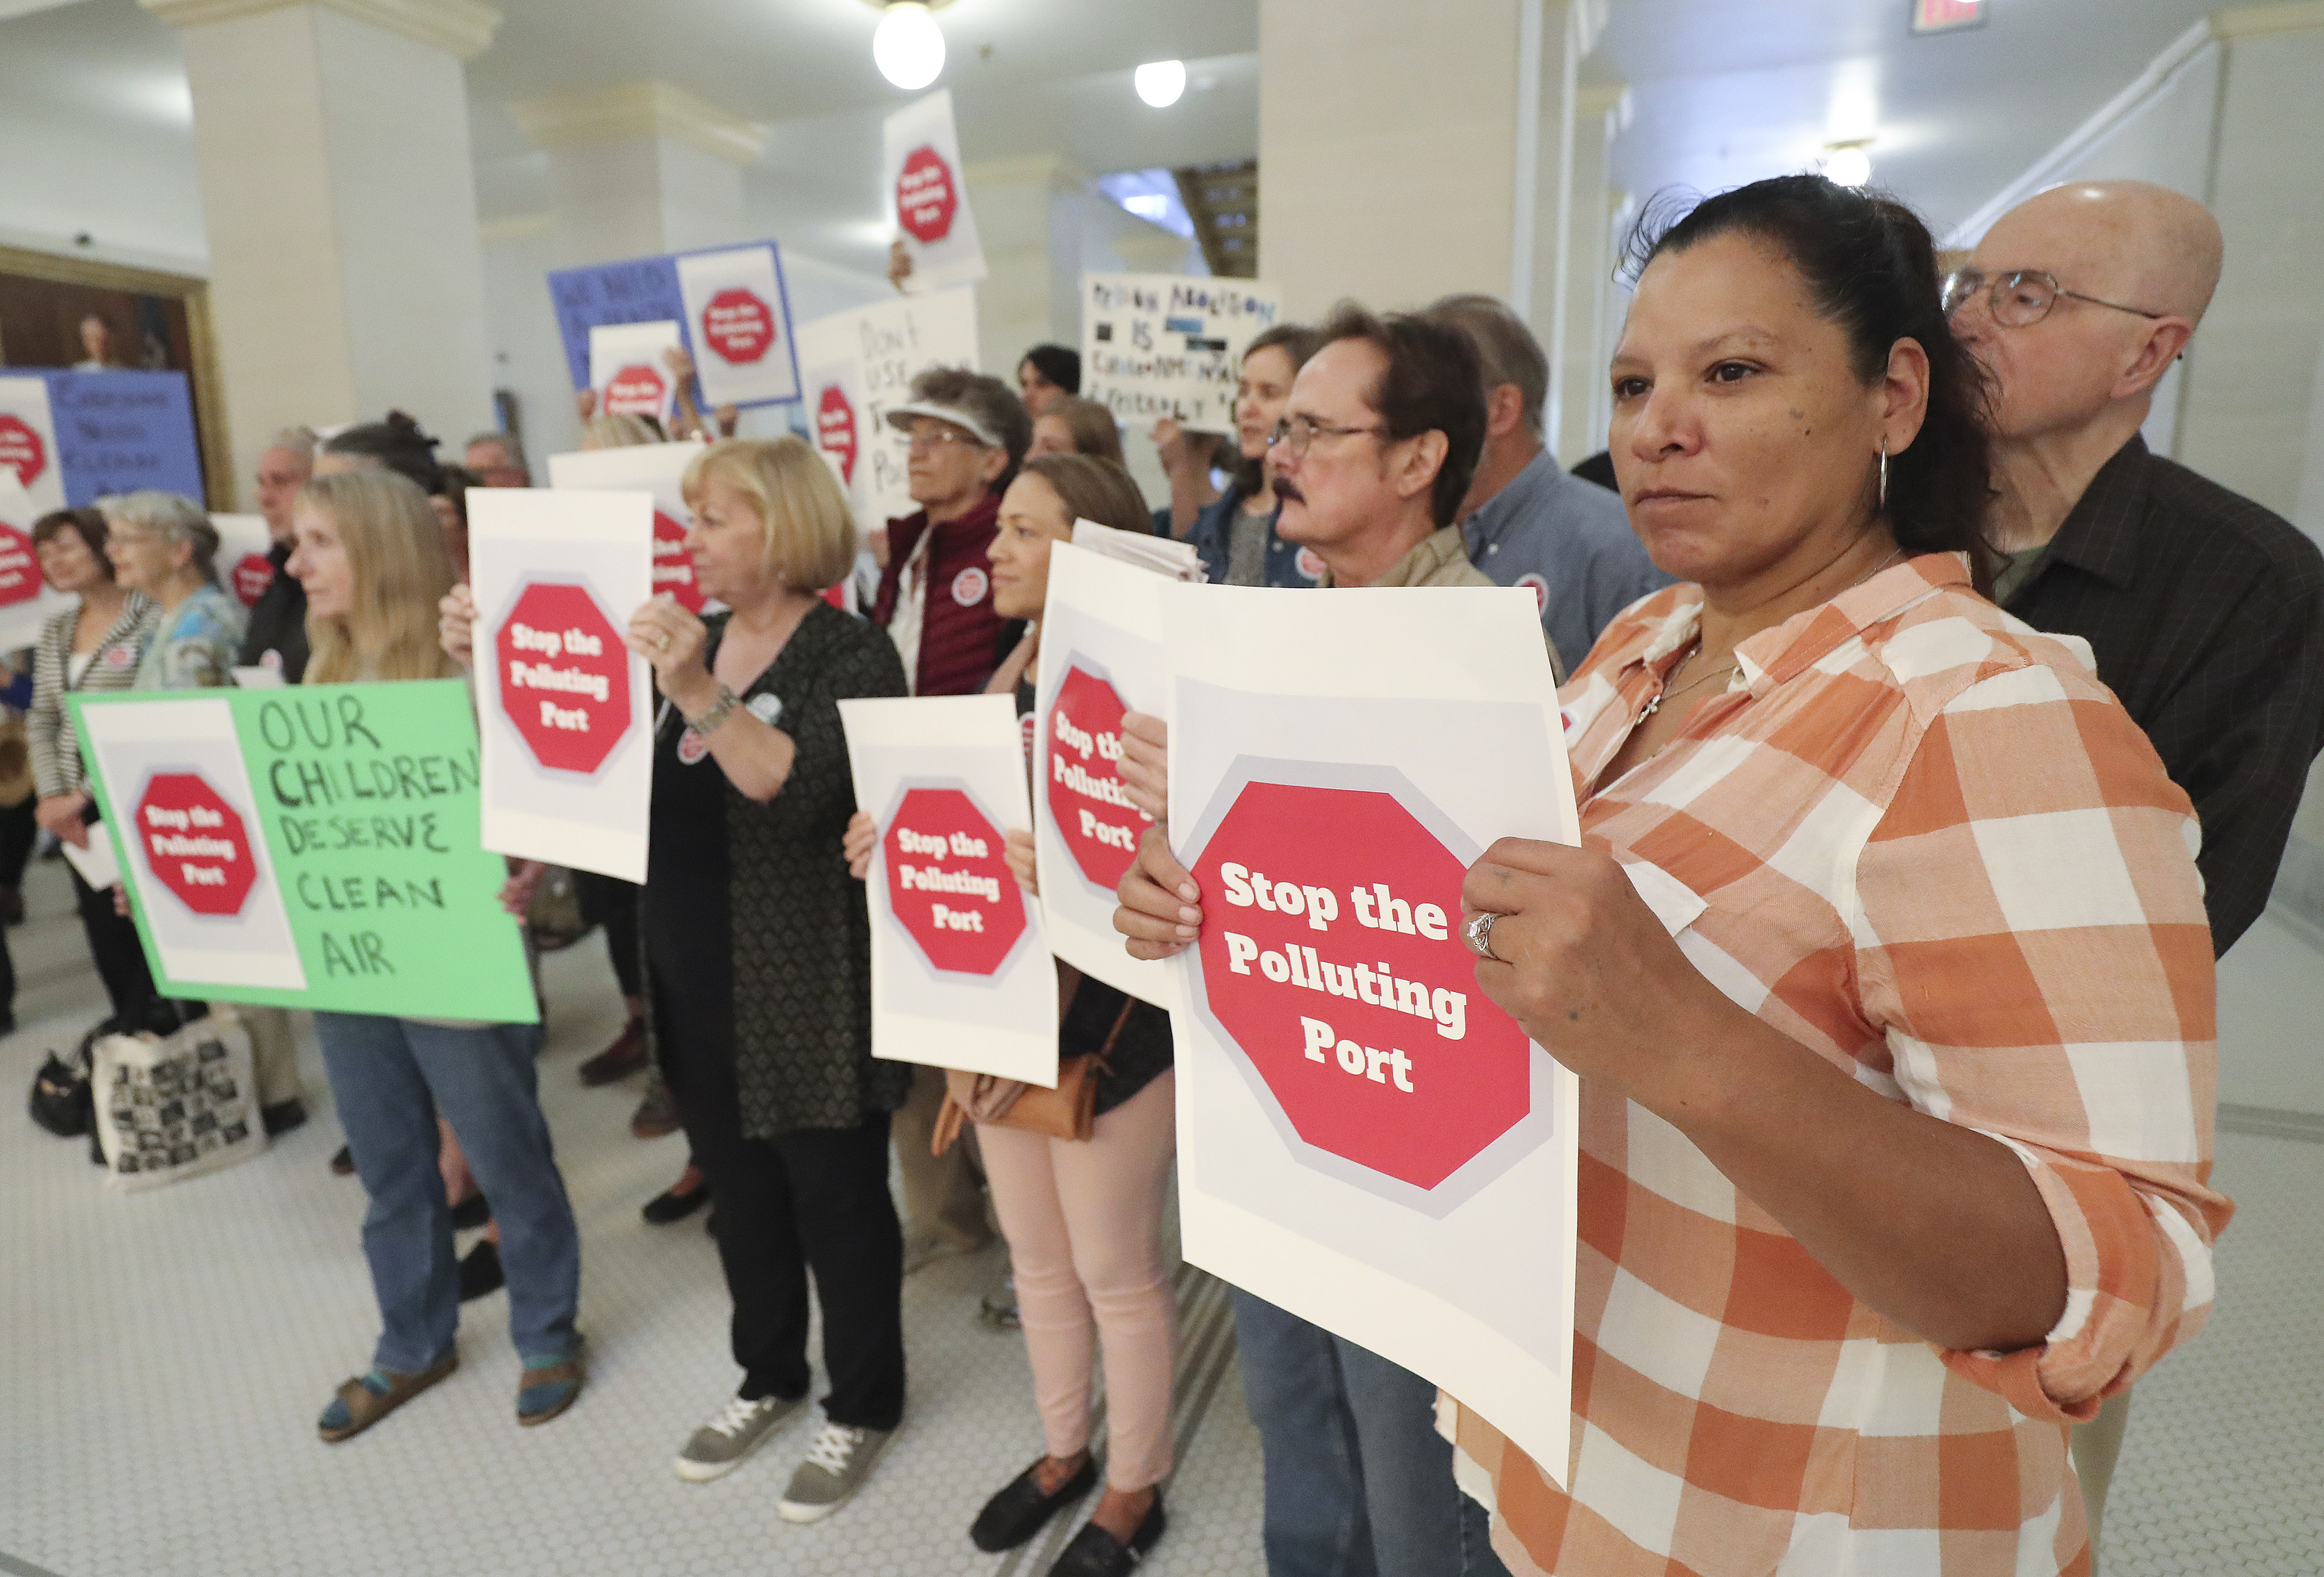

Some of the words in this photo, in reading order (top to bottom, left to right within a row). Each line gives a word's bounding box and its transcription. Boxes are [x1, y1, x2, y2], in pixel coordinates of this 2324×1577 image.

[511, 623, 562, 658] Stop
[563, 627, 603, 657] the
[510, 660, 610, 703] Polluting
[259, 694, 382, 753] OUR
[539, 700, 590, 733] Port
[1055, 711, 1094, 760] Stop
[1095, 731, 1125, 760] th
[269, 748, 480, 809] CHILDREN
[278, 811, 450, 856] DESERVE
[897, 827, 948, 861] Stop
[949, 831, 989, 858] the
[1078, 807, 1136, 852] Port
[296, 871, 447, 911] CLEAN
[898, 864, 1001, 903] Polluting
[1220, 862, 1339, 932] Stop
[1350, 882, 1449, 941] the
[931, 903, 985, 933] Port
[320, 929, 396, 977] AIR
[1223, 930, 1468, 1041] Polluting
[1300, 1015, 1415, 1094] Port
